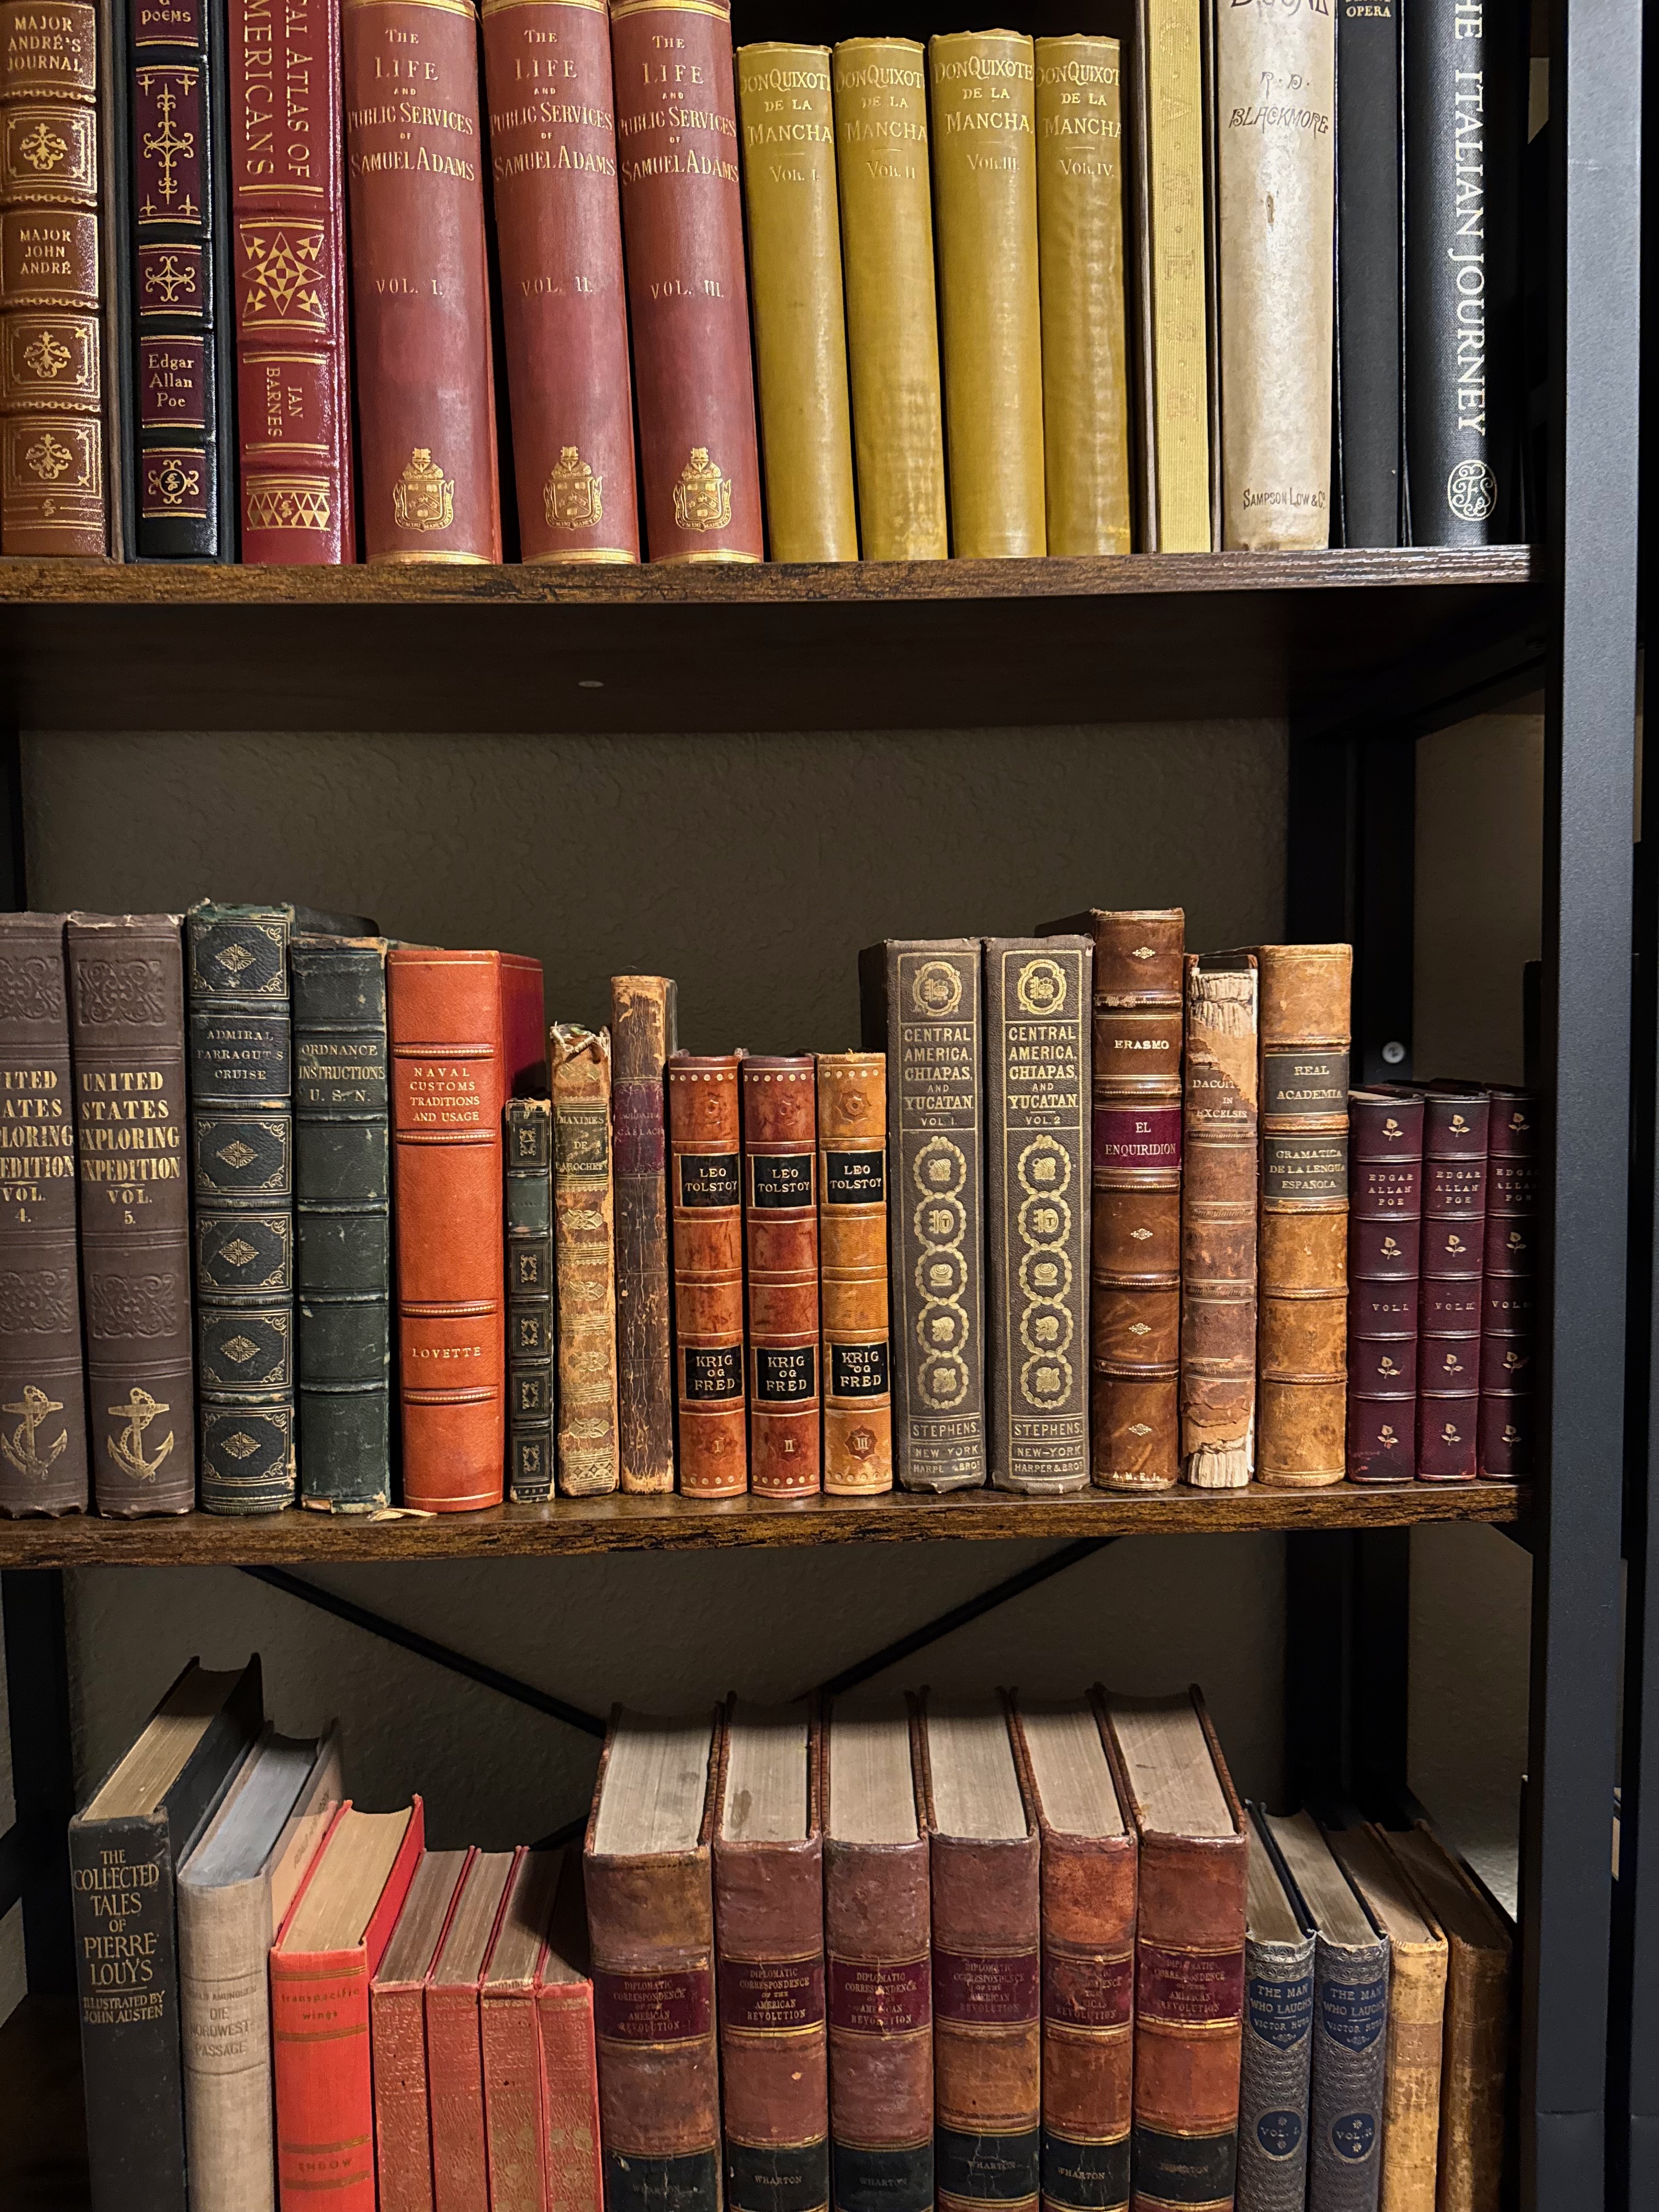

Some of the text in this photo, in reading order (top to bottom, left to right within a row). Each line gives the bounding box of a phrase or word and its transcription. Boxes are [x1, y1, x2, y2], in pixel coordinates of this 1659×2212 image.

[1346, 5, 1392, 18] OPERA
[15, 16, 73, 31] MAJOR
[385, 29, 419, 44] THE
[524, 29, 557, 43] THE
[652, 35, 685, 49] THE
[7, 56, 83, 73] JOURNAL
[375, 56, 439, 81] LIFE
[515, 58, 578, 81] LIFE
[934, 55, 1034, 83] DON QUIXOTE
[642, 63, 704, 84] LIFE
[286, 47, 313, 133] ATLAS
[662, 92, 684, 100] AND
[963, 87, 1011, 100] DE LA
[764, 99, 812, 112] DE LA
[861, 96, 910, 109] DE LA
[1062, 93, 1108, 105] DE LA
[347, 102, 473, 136] PUBLIC SERVICES
[490, 101, 613, 137] PUBLIC SERVICES
[669, 106, 737, 138] SERVICES
[1229, 106, 1329, 139] BLACKMORE
[748, 123, 834, 147] MANCHA
[845, 120, 928, 143] MANCHA
[287, 144, 311, 179] OF
[351, 146, 475, 182] SAMUEL ADAMS
[494, 145, 616, 182] SAMUEL ADAMS
[622, 150, 739, 186] SAMUEL ADAMS
[20, 229, 72, 242] MAJOR
[25, 245, 65, 258] JOHN
[1447, 70, 1486, 437] ITALIAN JOURNEY
[20, 259, 72, 275] ANDRÉ
[376, 278, 419, 295] VOL.
[148, 354, 195, 370] Edgar
[149, 372, 193, 388] Allan
[157, 392, 187, 408] Poe
[266, 367, 283, 437] BARNES
[287, 386, 303, 419] IAN
[1243, 487, 1310, 510] SAMPSON LOW
[207, 1030, 274, 1042] ADMIRAL
[904, 1028, 971, 1042] CENTRAL
[1008, 1026, 1077, 1041] CENTRAL
[301, 1044, 379, 1056] ORDNANCE
[1114, 1040, 1170, 1050] ERASMO
[215, 1069, 267, 1080] CRUISE
[298, 1065, 385, 1080] INSTRUCTIONS
[414, 1067, 470, 1077] NAVAL
[1294, 1065, 1330, 1075] REAL
[82, 1071, 163, 1092] UNITED
[410, 1081, 476, 1091] CUSTOMS
[1032, 1083, 1054, 1092] AND
[927, 1084, 950, 1093] AND
[1276, 1089, 1344, 1099] ACADEMIA
[310, 1089, 371, 1102] U. N.
[411, 1096, 481, 1107] TRADITIONS
[82, 1100, 169, 1120] STATES
[413, 1111, 480, 1122] AND USAGE
[1196, 1109, 1248, 1118] EXCELSIS
[558, 1116, 604, 1125] MAXIMES
[1135, 1122, 1152, 1133] EL
[573, 1141, 588, 1149] DE
[1105, 1143, 1176, 1156] ENQUIRIDION
[699, 1167, 727, 1178] LEO
[772, 1169, 799, 1179] LEO
[844, 1165, 871, 1175] LEO
[1269, 1163, 1346, 1173] DE LA LENGUA
[685, 1180, 738, 1192] TOLSTOY
[757, 1181, 810, 1193] TOLSTOY
[829, 1178, 882, 1190] TOLSTOY
[1282, 1180, 1337, 1189] ESPAÑOLA
[1368, 1186, 1412, 1194] ALLAN
[1435, 1184, 1479, 1192] ALLAN
[106, 1188, 153, 1204] VOL.
[124, 1210, 136, 1224] 5.
[412, 1346, 482, 1358] LOVETTE
[842, 1351, 879, 1364] KRIG
[695, 1354, 733, 1368] KRIG
[768, 1355, 805, 1368] KRIG
[707, 1369, 725, 1378] OG
[779, 1369, 797, 1378] OG
[854, 1365, 871, 1373] OG
[695, 1378, 736, 1391] FRED
[766, 1379, 808, 1392] FRED
[840, 1374, 882, 1387] FRED
[912, 1421, 980, 1437] STEPHENS.
[1014, 1422, 1084, 1437] STEPHENS.
[100, 1849, 126, 1865] THE
[74, 1864, 160, 1891] COLLECTED
[90, 1893, 142, 1917] TALES
[109, 1918, 126, 1933] OF
[84, 1932, 157, 1959] PIERRE
[750, 1968, 799, 1978] DIPLOMATIC
[739, 1977, 810, 1990] CORRESPONDENCE
[1257, 1983, 1308, 1999] THE MAN
[83, 1990, 165, 2010] ILLUSTRATED BY
[755, 1999, 797, 2010] AMERICAN
[1250, 1997, 1273, 2013] WHO
[84, 2005, 163, 2024] JOHN AUSTEN
[747, 2009, 806, 2022] REVOLUTION
